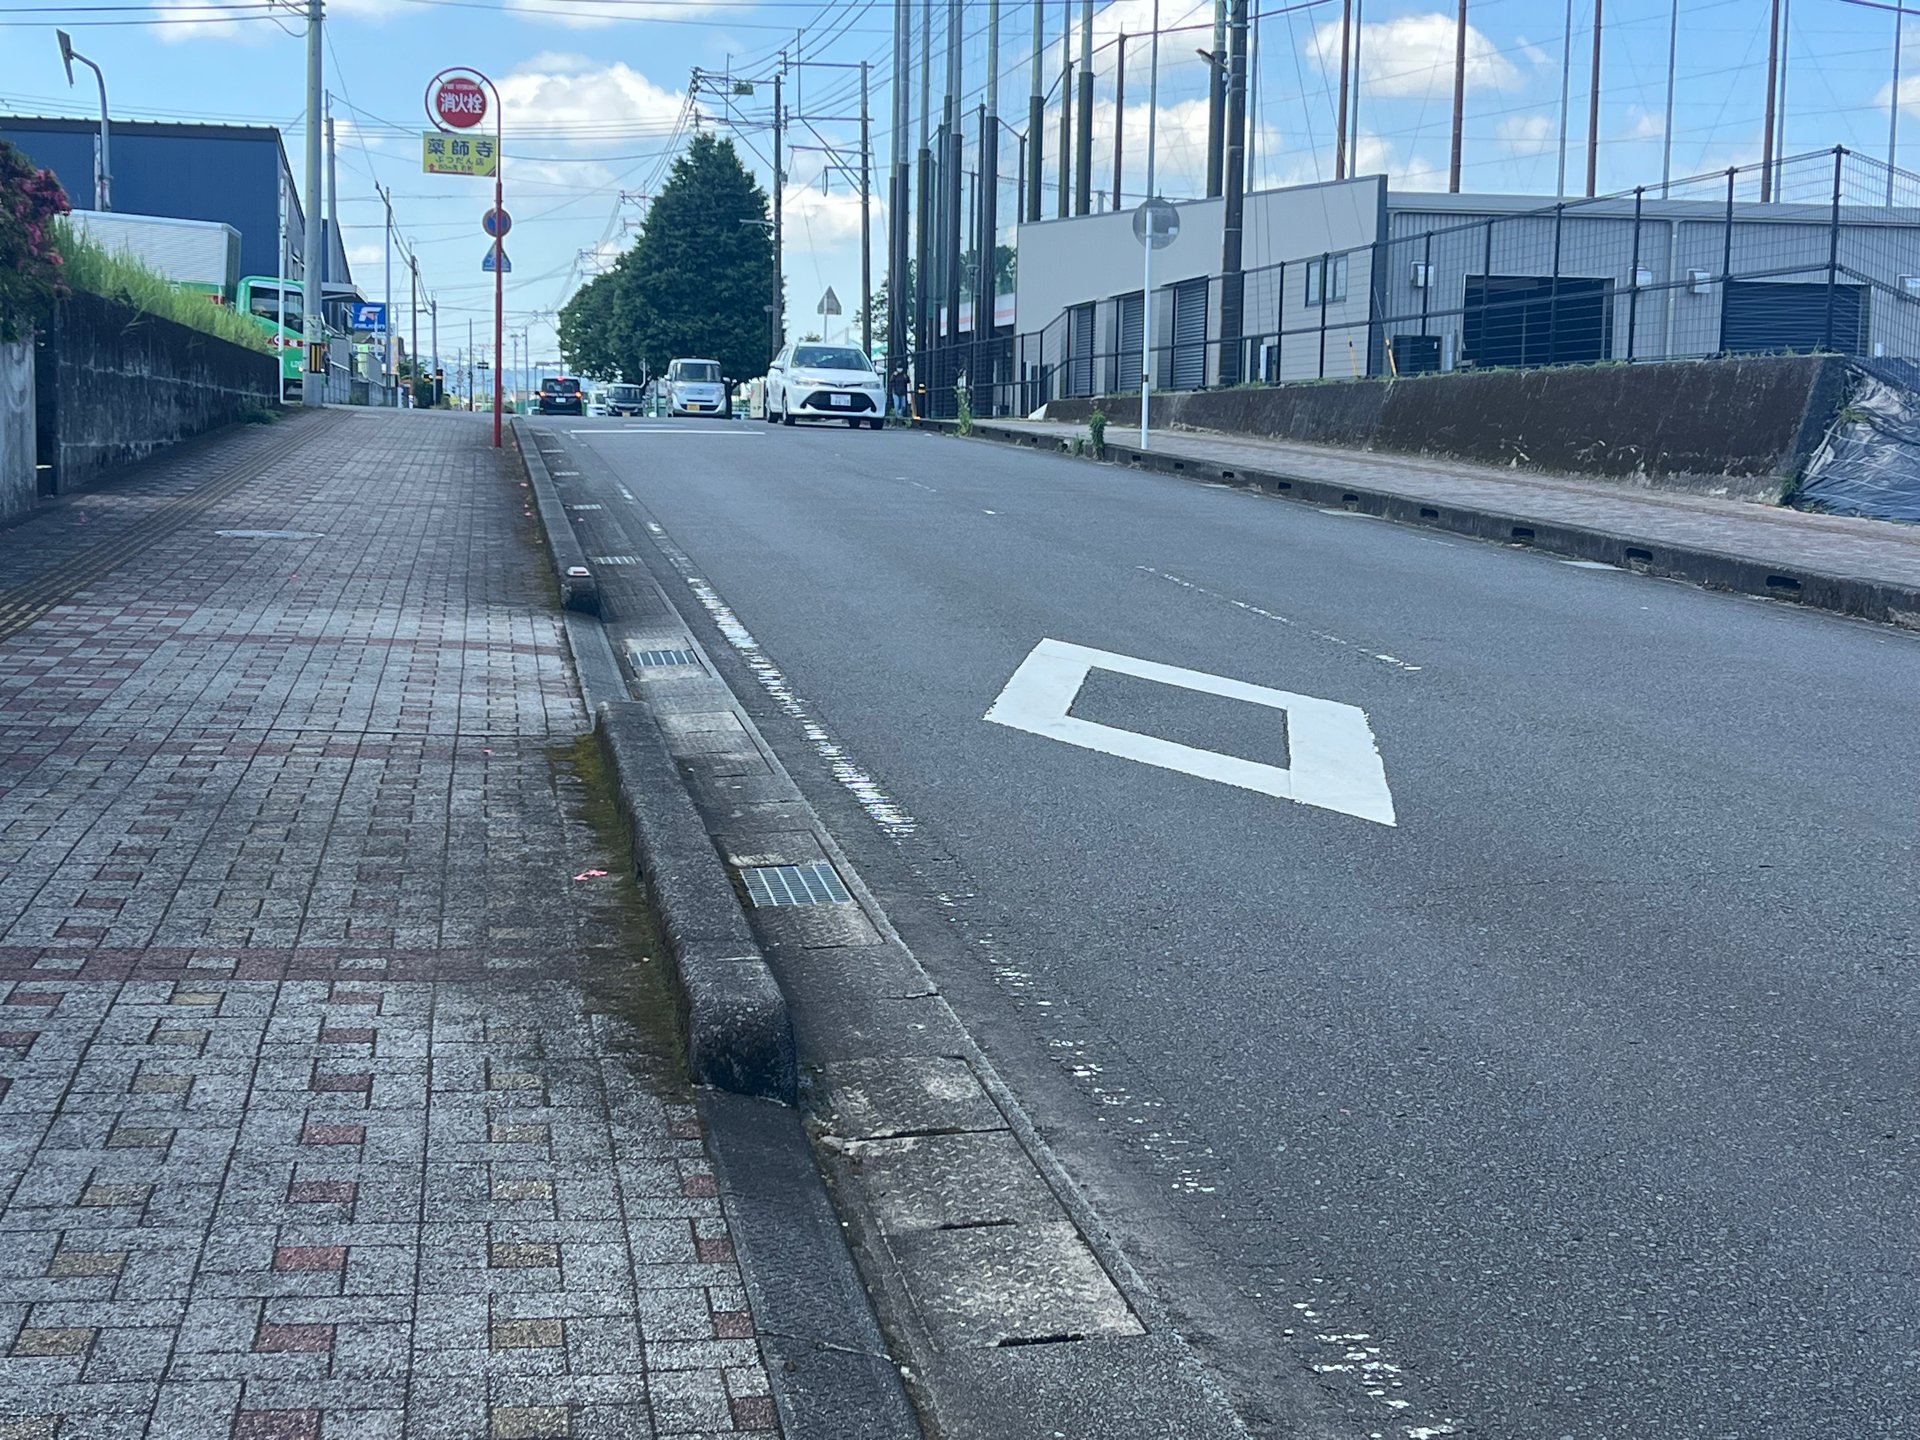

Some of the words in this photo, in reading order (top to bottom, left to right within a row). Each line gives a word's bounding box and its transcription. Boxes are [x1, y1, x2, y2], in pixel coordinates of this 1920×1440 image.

[440, 92, 483, 113] 消火栓
[428, 138, 494, 158] 薬師寺
